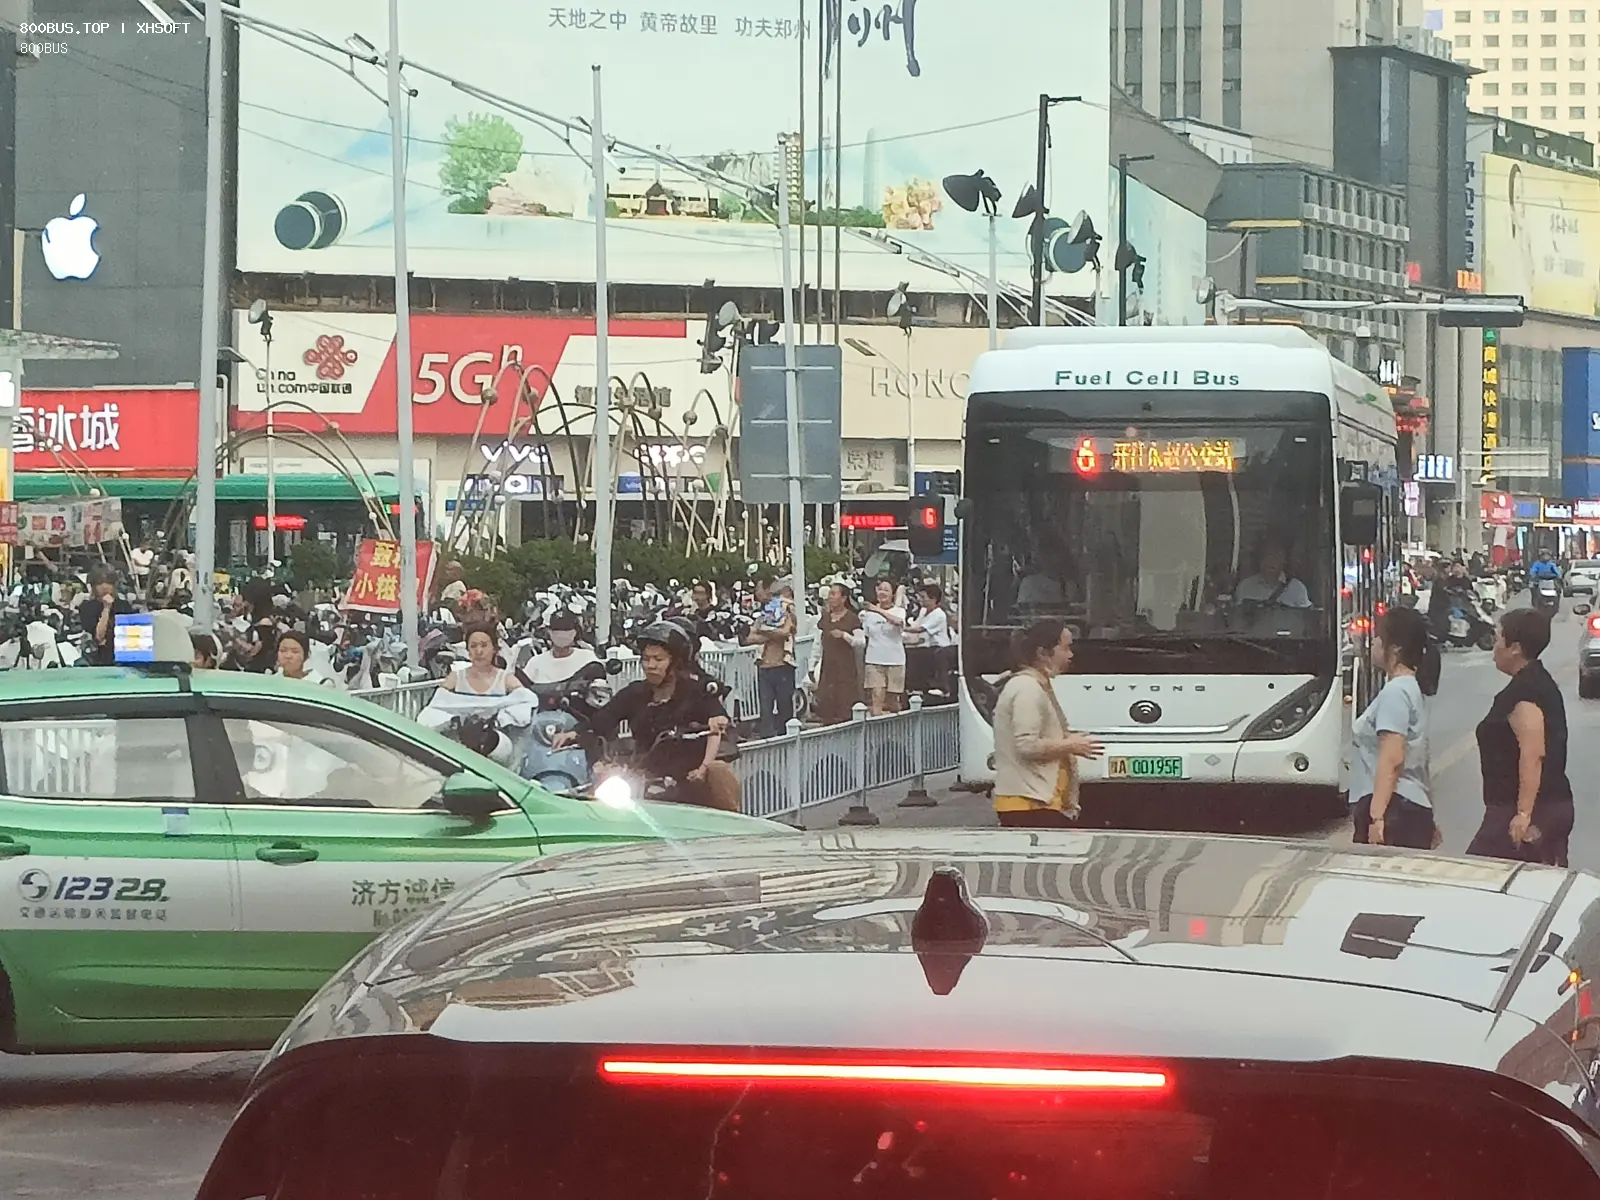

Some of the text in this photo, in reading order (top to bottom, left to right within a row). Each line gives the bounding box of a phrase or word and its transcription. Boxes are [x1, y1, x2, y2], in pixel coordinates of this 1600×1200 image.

[548, 8, 812, 40] 天地之中 黄帝故里 功夫郑州
[1055, 371, 1239, 385] Fuel Cell Bus
[1075, 438, 1096, 472] 6
[924, 507, 937, 526] 6
[54, 876, 166, 901] 12328
